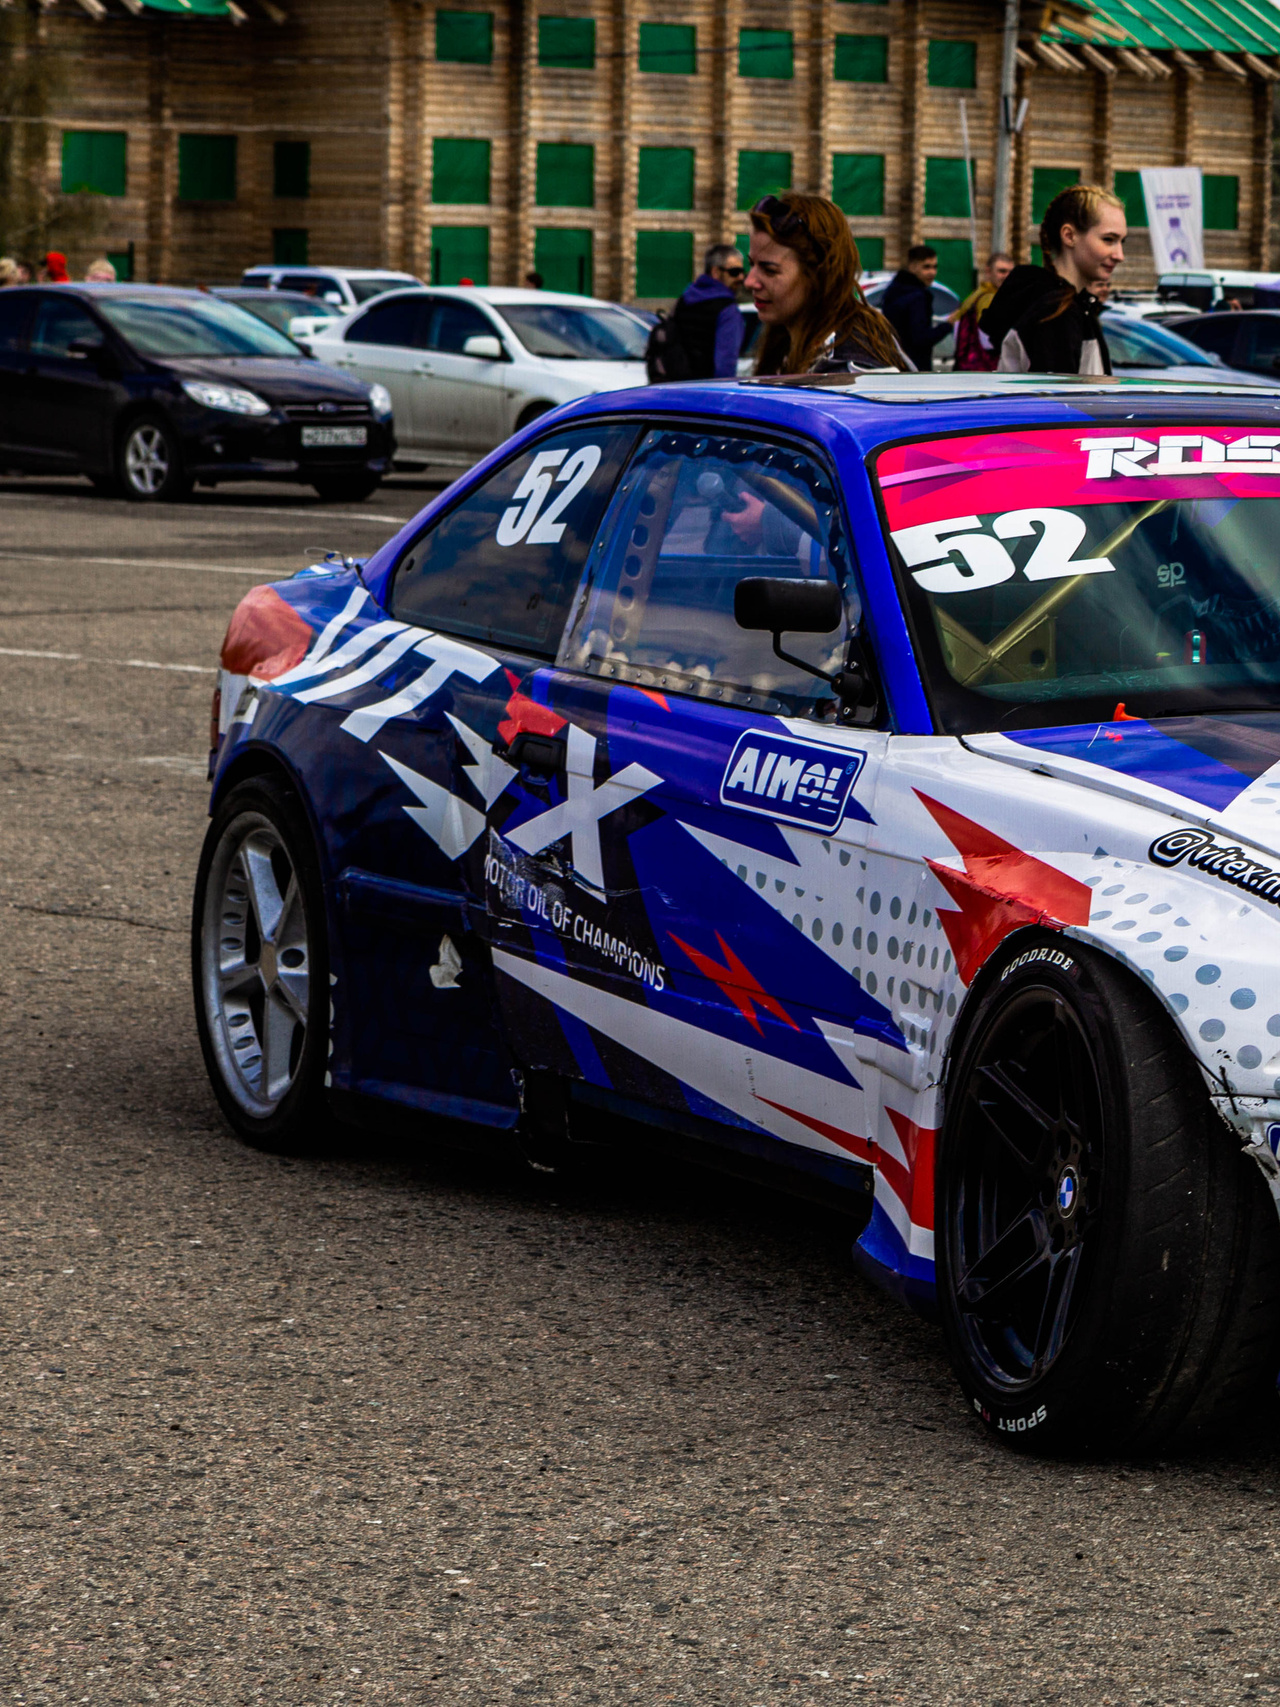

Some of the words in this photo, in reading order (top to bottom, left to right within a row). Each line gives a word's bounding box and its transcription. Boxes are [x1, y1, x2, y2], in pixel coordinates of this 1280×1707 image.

[496, 445, 602, 547] 52
[889, 508, 1116, 593] 52
[726, 747, 843, 813] AIMOL
[552, 901, 572, 932] OF
[573, 914, 666, 991] CHAMPIONS
[1001, 948, 1073, 981] GOODRIDE
[997, 1404, 1047, 1432] SPORT
